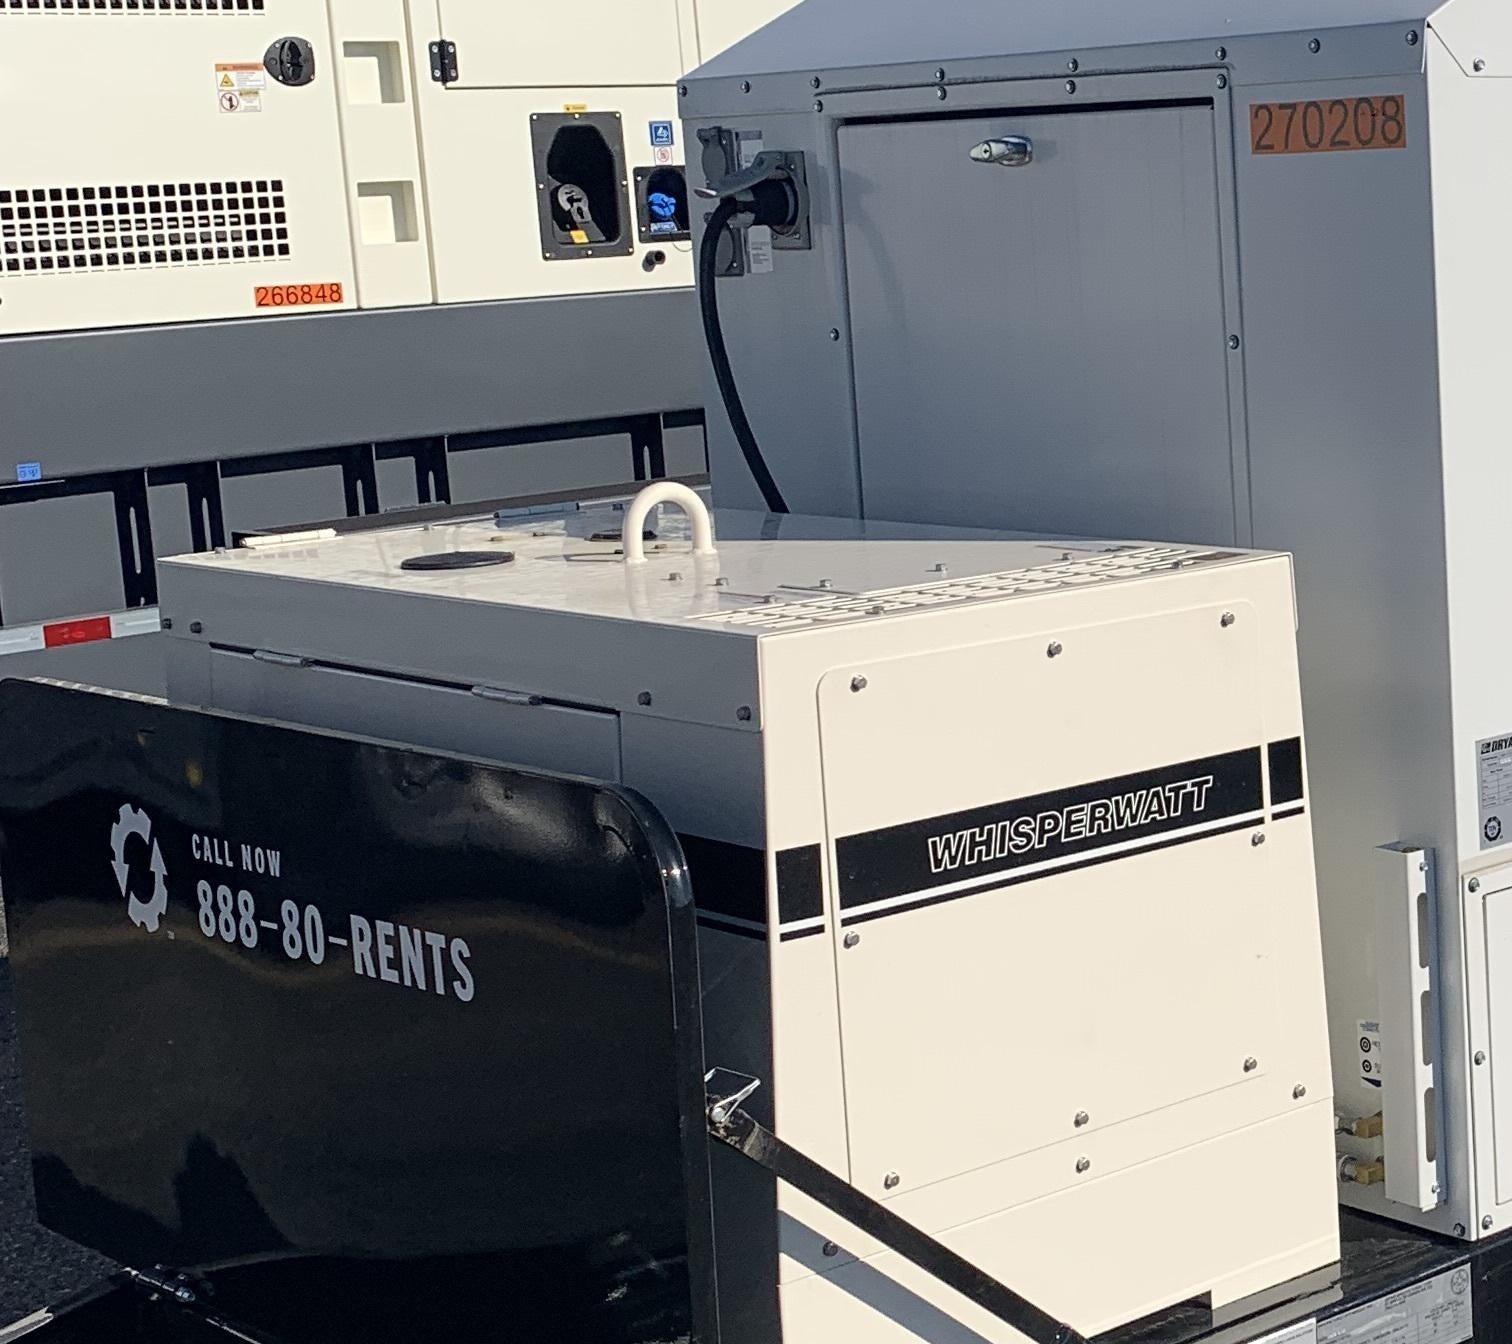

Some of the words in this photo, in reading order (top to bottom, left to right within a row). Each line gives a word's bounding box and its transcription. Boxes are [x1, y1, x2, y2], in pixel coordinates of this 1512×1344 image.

[1253, 96, 1404, 151] 270208
[256, 282, 342, 307] 266848
[927, 775, 1214, 873] WHISPERWATT
[192, 833, 234, 868] CALL
[240, 843, 281, 878] NOW
[196, 879, 475, 1003] 888-80-RENTS
